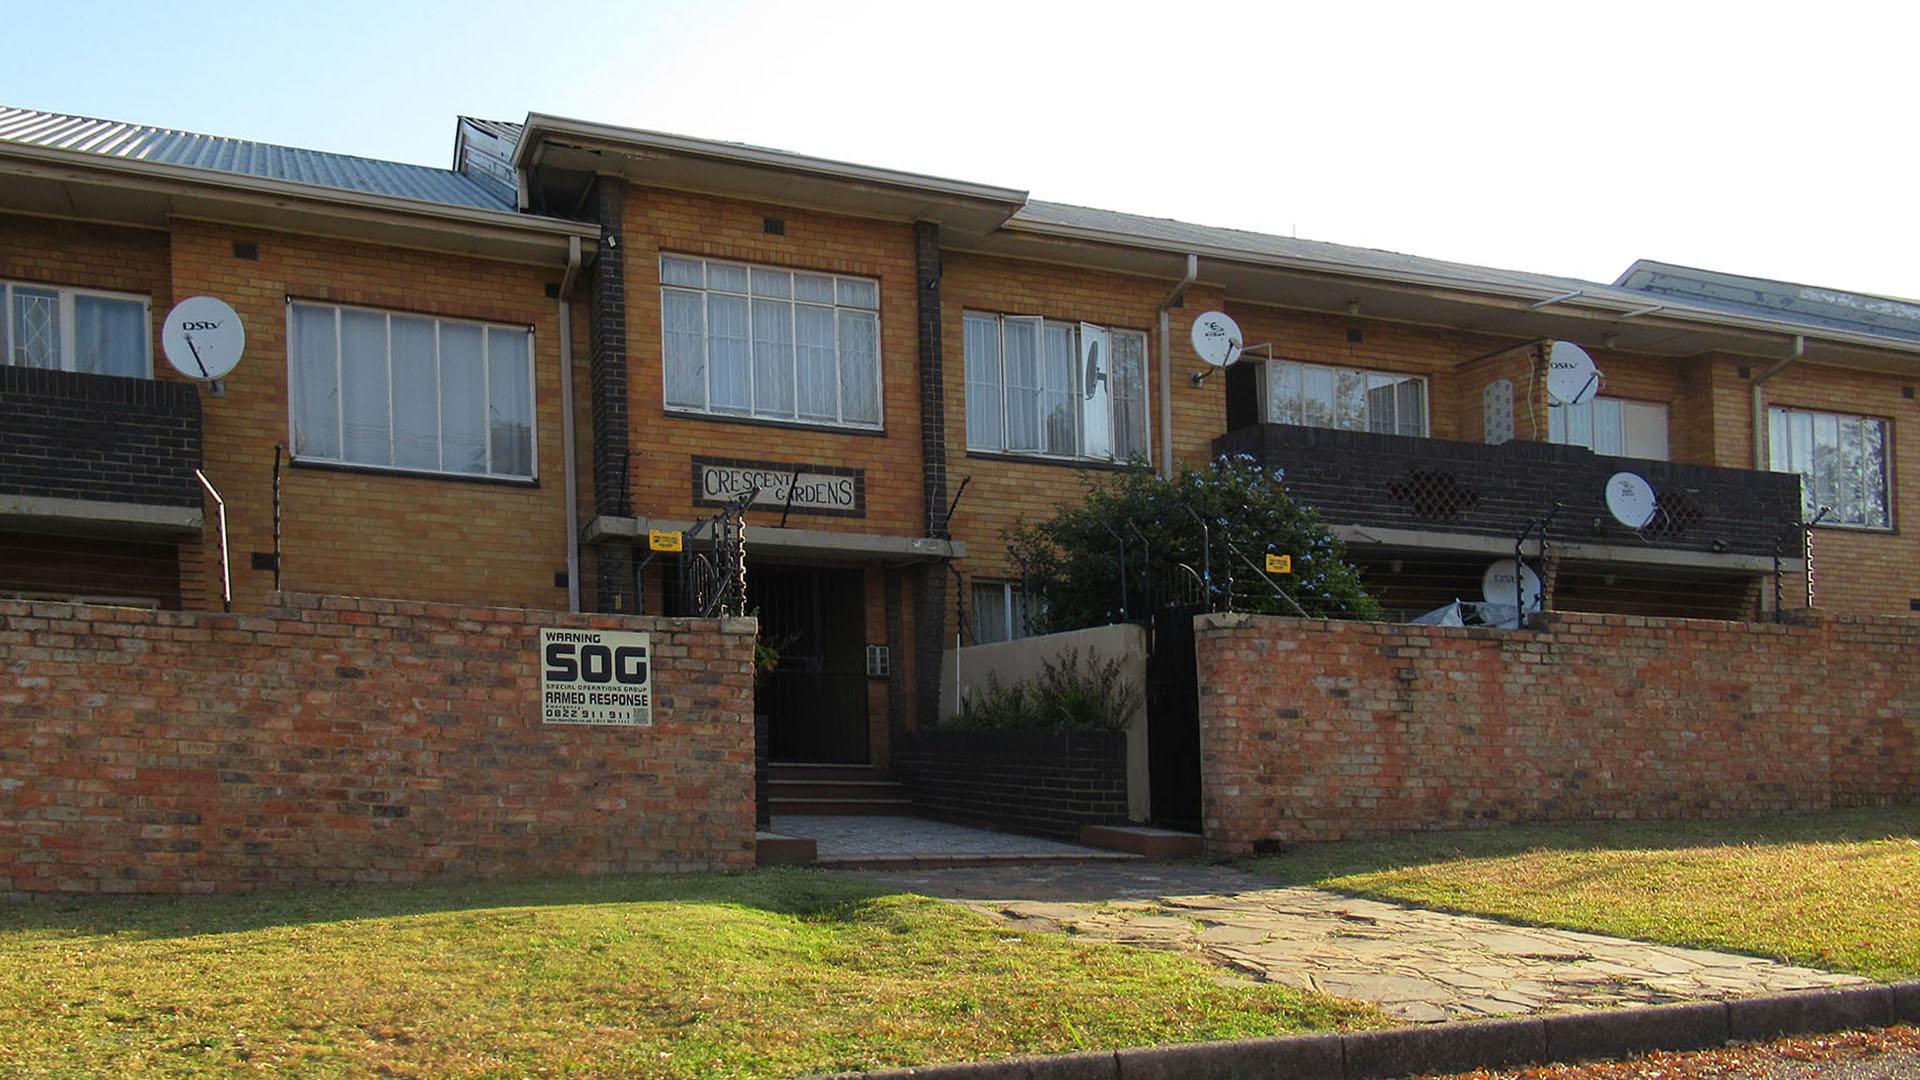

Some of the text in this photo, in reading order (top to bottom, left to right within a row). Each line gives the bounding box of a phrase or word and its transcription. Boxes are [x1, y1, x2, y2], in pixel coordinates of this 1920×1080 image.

[705, 469, 790, 495] CRESCENT
[545, 632, 601, 643] WARNING
[546, 643, 647, 684] SOG
[545, 692, 648, 706] ARMED RESPONSE
[546, 709, 630, 719] 0822 911 911
